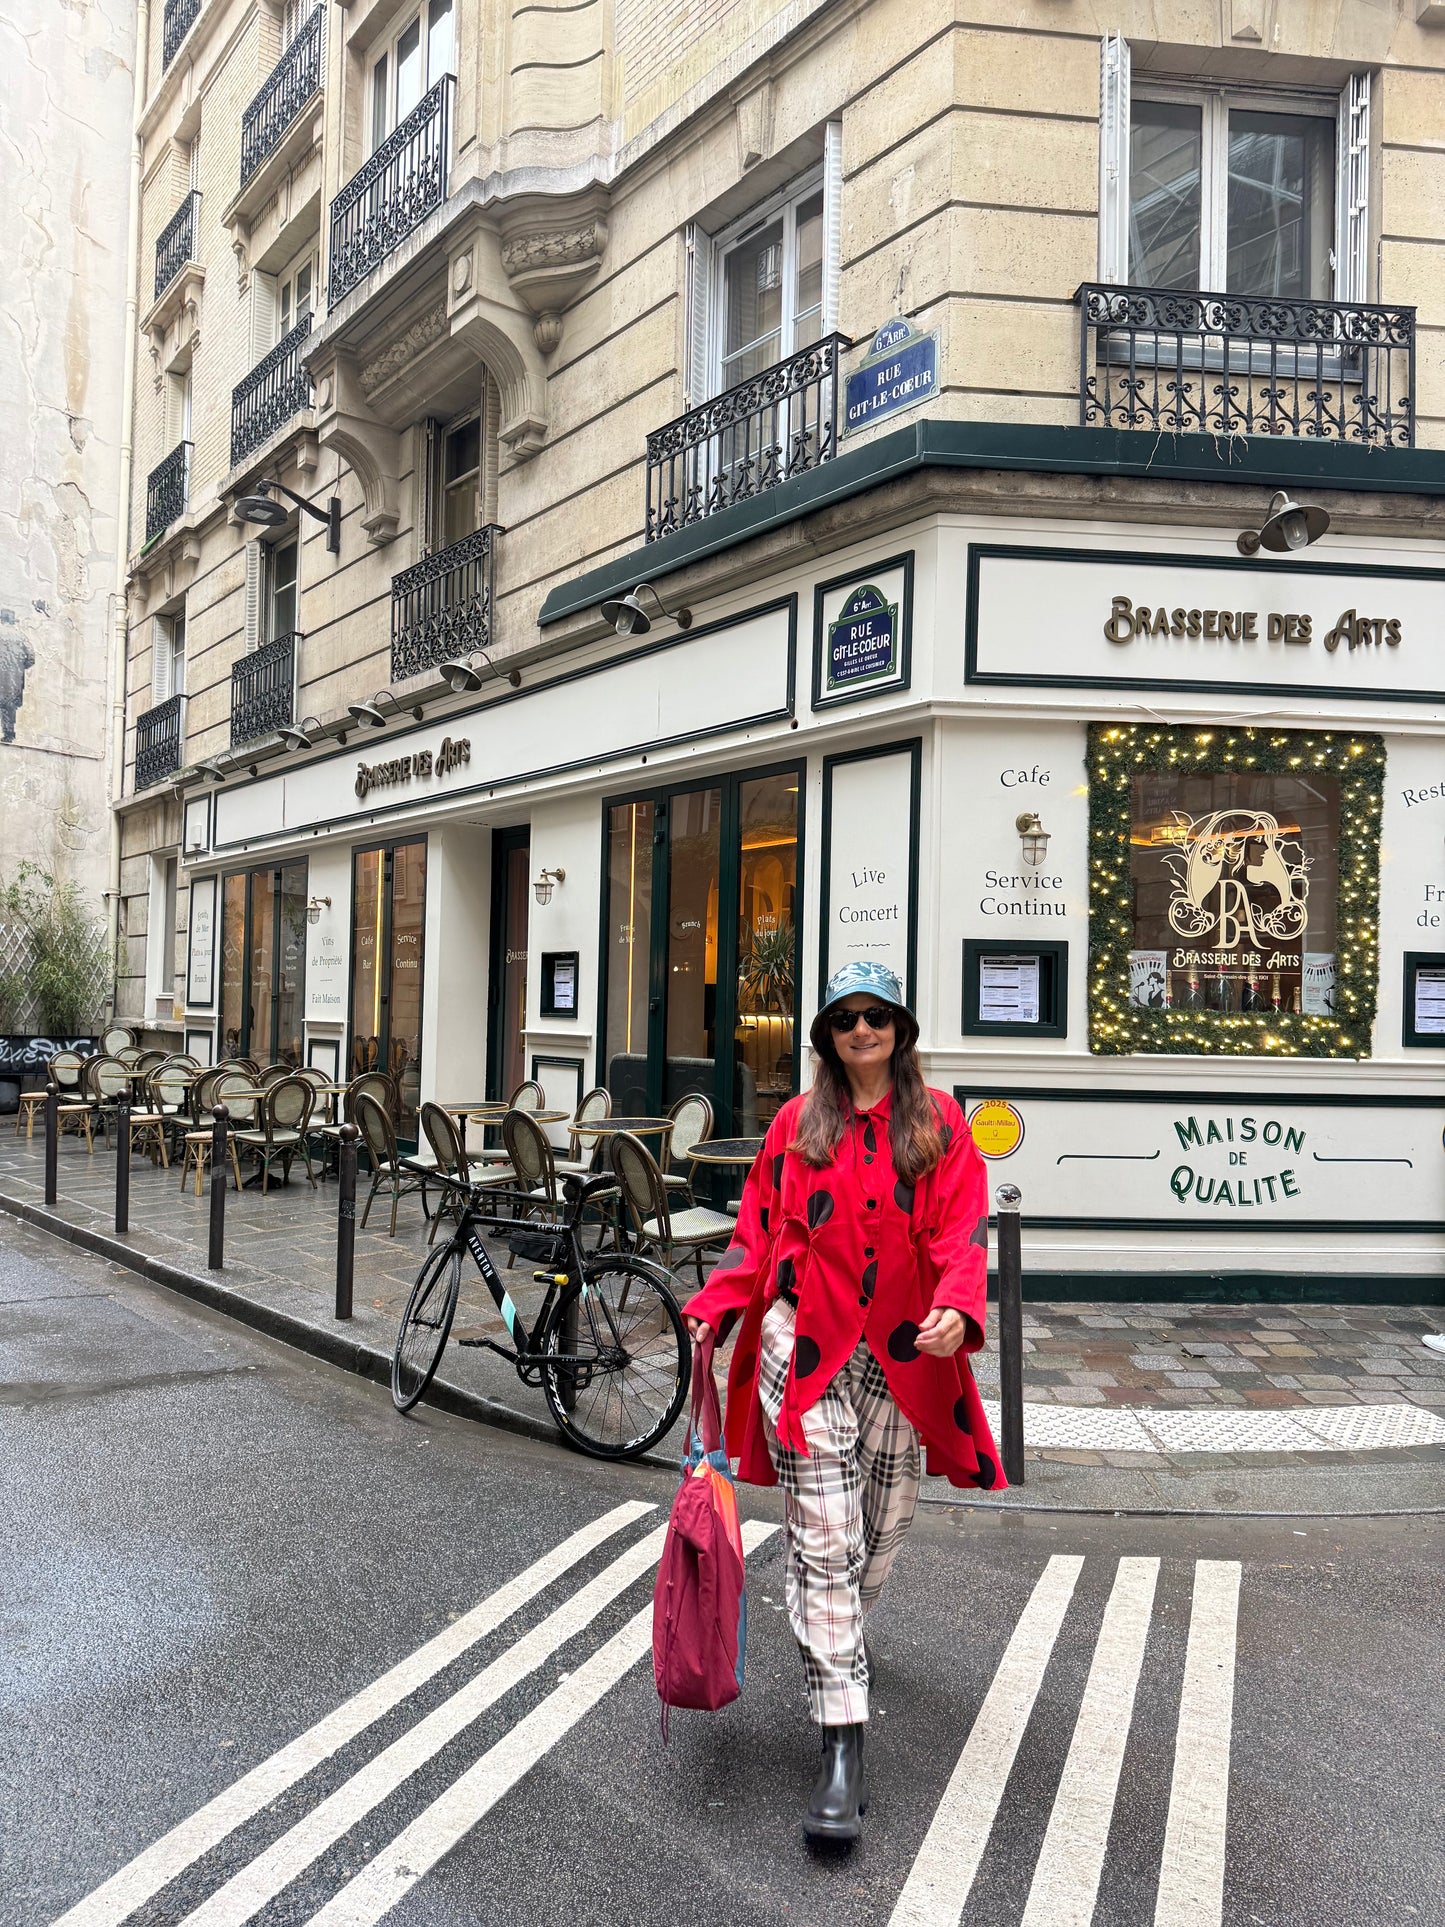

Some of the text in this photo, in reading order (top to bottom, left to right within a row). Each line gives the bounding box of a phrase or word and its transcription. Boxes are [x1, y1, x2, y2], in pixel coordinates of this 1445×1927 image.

[877, 363, 901, 386] RUE
[851, 621, 872, 640] RUE
[1103, 595, 1402, 652] BRASSERIE DES ARTS
[355, 736, 471, 798] BRASSERIE DES ARTS
[1000, 765, 1050, 788] Café
[851, 866, 886, 888] Live
[985, 870, 1063, 889] Service
[839, 904, 898, 923] Concert
[980, 897, 1067, 916] Continu
[681, 920, 701, 930] Brunch
[757, 915, 776, 925] Plats
[1416, 910, 1440, 927] de
[322, 936, 334, 946] Vins
[361, 935, 374, 946] Café
[397, 933, 417, 945] Service
[755, 929, 763, 937] du
[312, 955, 342, 968] de Propriété
[362, 959, 372, 969] Bar
[395, 958, 418, 969] Continu
[1173, 948, 1300, 970] BRASSERIE DES ARTS
[312, 994, 341, 1004] Fait Maison
[984, 1100, 1007, 1109] 2025
[1173, 1116, 1306, 1155] MAISON
[1229, 1151, 1247, 1166] DE
[468, 1236, 494, 1278] AVENTON
